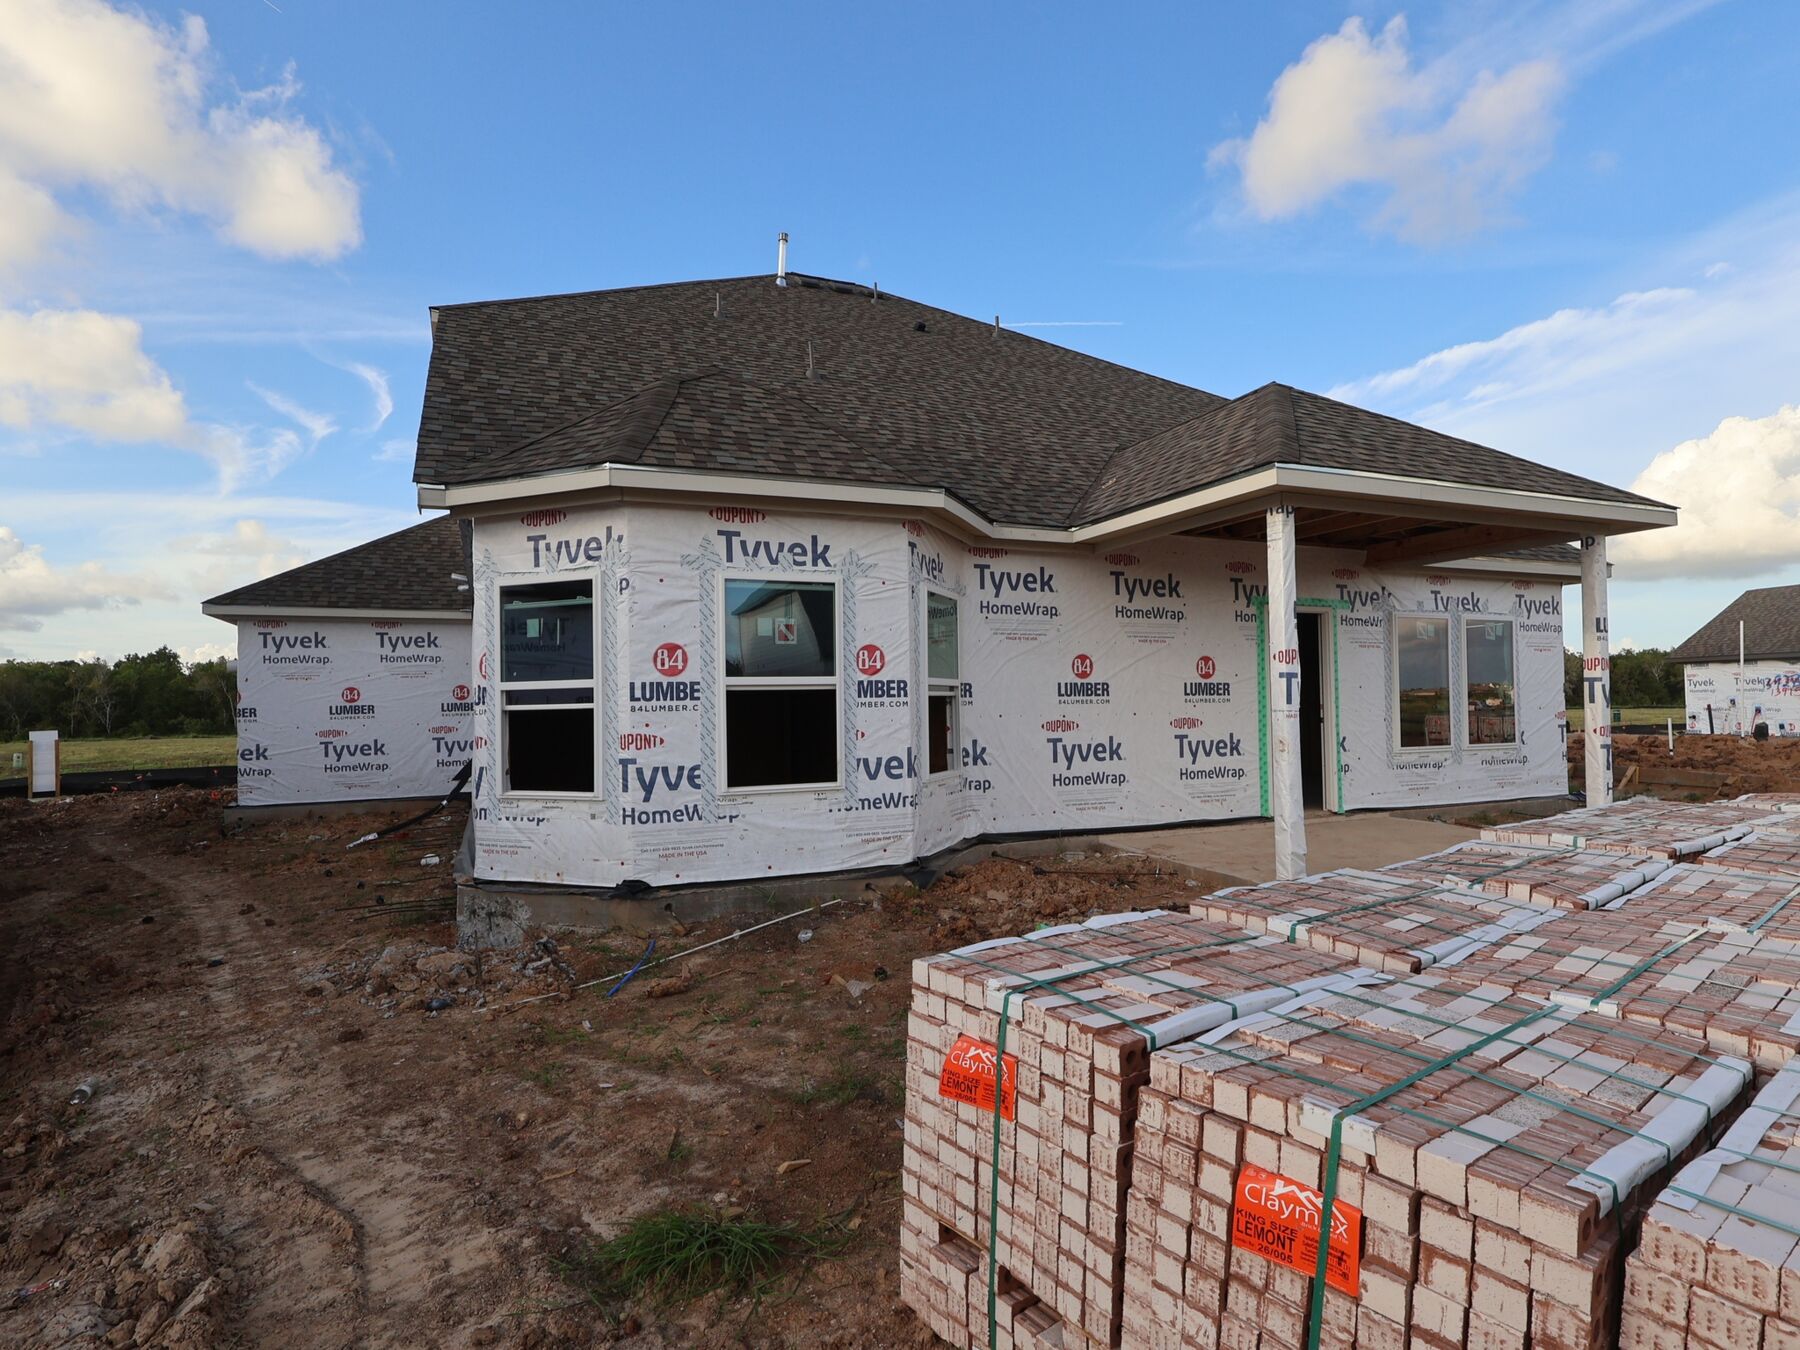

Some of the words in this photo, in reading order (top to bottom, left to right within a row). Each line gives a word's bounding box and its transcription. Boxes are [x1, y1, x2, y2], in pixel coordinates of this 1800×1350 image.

[527, 510, 563, 527] DUPONT
[716, 507, 761, 524] DUPONT
[973, 547, 1005, 559] DUPONT
[1109, 554, 1137, 566] DUPONT
[1229, 561, 1254, 573] DUPONT
[973, 564, 1054, 598] Tyvek
[1110, 571, 1181, 602] Tyvek
[1230, 578, 1267, 608] Tyv
[980, 601, 1058, 619] HomeWrap
[1515, 594, 1560, 619] Tyvek
[1115, 606, 1184, 623] HomeWrap
[1340, 615, 1383, 628] HomeWr
[257, 620, 284, 628] DUPONT
[374, 621, 401, 629] DUPONT
[1519, 621, 1562, 634] HomeWrap
[258, 632, 327, 653] Tyvek
[376, 632, 438, 653] Tyvek
[263, 655, 330, 666] HomeWrap
[380, 654, 442, 665] HomeWrap
[656, 649, 684, 670] 84
[858, 650, 882, 669] 84
[1074, 659, 1091, 674] 84
[1198, 660, 1214, 675] 84
[858, 680, 908, 698] MBER
[1057, 682, 1110, 697] LUMBER
[1184, 682, 1230, 697] LUMBER
[1688, 679, 1714, 688] Tyvek
[343, 689, 360, 700] 84
[454, 687, 470, 698] 84
[629, 681, 700, 702] LUMBE
[329, 704, 375, 716] LUMBER
[630, 704, 698, 713] 84LUMBER.C
[432, 726, 455, 734] DUPONT
[1046, 720, 1075, 732] DUPONT
[1173, 717, 1200, 729] DUPONT
[319, 729, 345, 738] DUPONT
[620, 734, 657, 750] UPONT
[1174, 733, 1242, 765] Tyvek
[320, 739, 386, 762] Tyvek
[1047, 736, 1123, 770] Tyvek
[238, 768, 272, 778] Wrap
[324, 763, 389, 774] HomeWrap
[1180, 766, 1245, 780] HomeWrap
[619, 758, 701, 802] Tyve
[1052, 772, 1127, 787] HomeWrap
[951, 1050, 1009, 1081] Claymx
[943, 1068, 960, 1079] KING
[963, 1074, 981, 1085] SIZE
[941, 1075, 978, 1096] LEMONT
[1245, 1183, 1348, 1239] Claymx
[1237, 1208, 1265, 1226] KING
[1270, 1221, 1298, 1238] SIZE
[1236, 1218, 1295, 1253] LEMONT
[1258, 1243, 1293, 1264] 26/005
